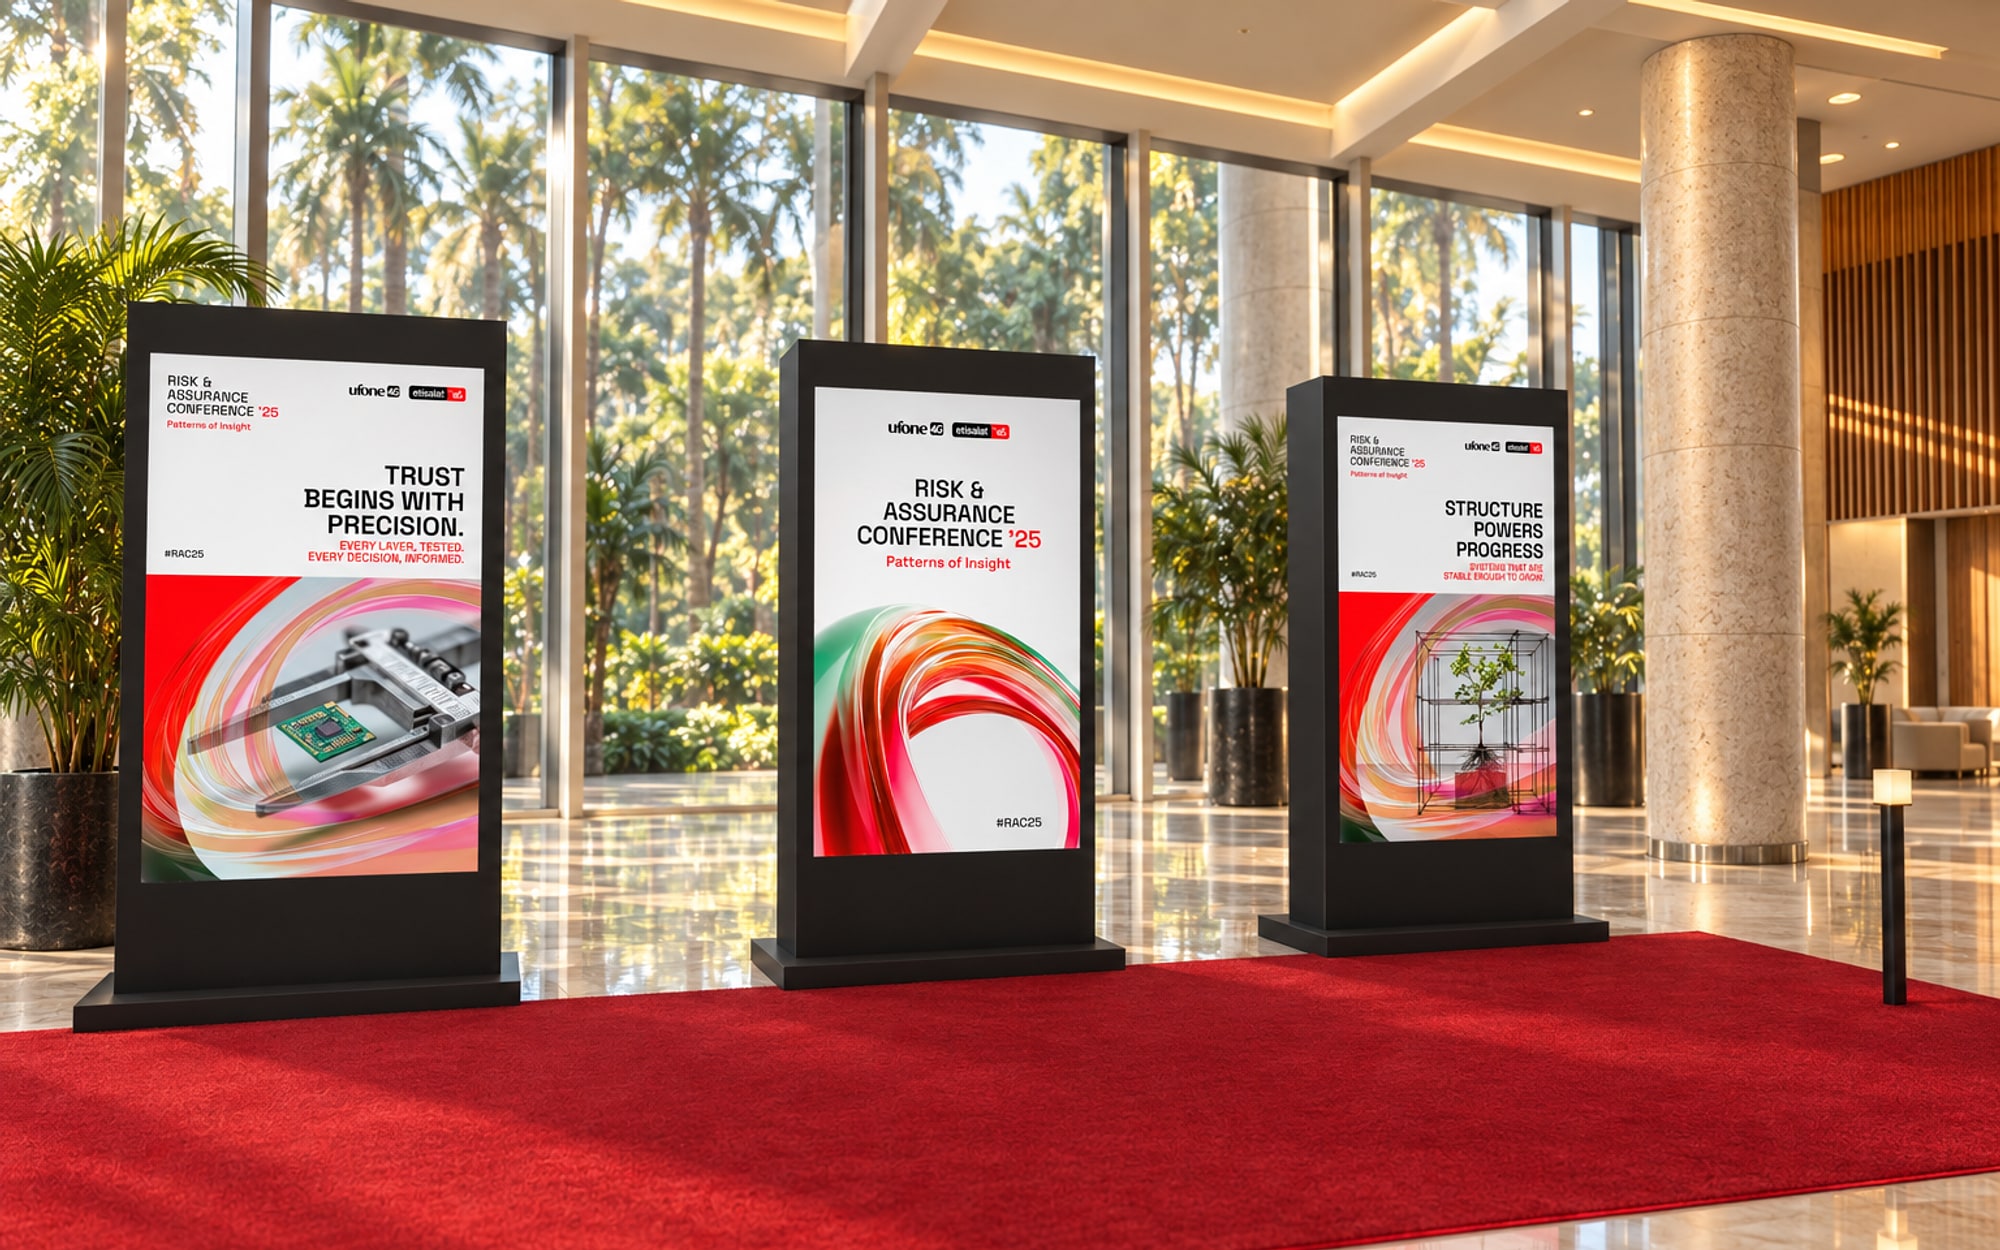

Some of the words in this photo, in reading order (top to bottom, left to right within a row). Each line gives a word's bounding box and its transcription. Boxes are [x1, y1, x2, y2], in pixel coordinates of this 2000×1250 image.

[168, 375, 198, 387] RISK
[203, 376, 212, 388] &
[168, 390, 248, 403] ASSURANCE
[349, 384, 384, 396] ufone
[167, 403, 254, 416] CONFERENCE
[258, 406, 278, 417] '25
[167, 421, 206, 429] Patterns
[208, 421, 218, 430] of
[220, 422, 251, 432] Insight
[889, 421, 928, 434] ufone
[931, 423, 943, 435] 4G
[956, 426, 988, 435] etisalat
[1351, 435, 1370, 443] RISK
[1351, 446, 1405, 456] ASSURANCE
[1465, 441, 1490, 451] ufone
[385, 466, 464, 486] TRUST
[915, 479, 963, 498] RISK
[971, 481, 984, 498] &
[305, 489, 393, 510] BEGINS
[402, 492, 463, 511] WITH
[884, 502, 1015, 524] ASSURANCE
[1445, 500, 1543, 518] STRUCTURE
[328, 515, 463, 536] PRECISION.
[1474, 522, 1543, 538] POWERS
[858, 526, 1003, 547] CONFERENCE
[1009, 530, 1041, 548] '25
[340, 541, 376, 551] EVERY
[420, 542, 464, 552] TESTED.
[1457, 542, 1543, 558] PROGRESS
[165, 550, 204, 558] #RAC25
[308, 552, 344, 562] EVERY
[405, 554, 464, 564] INFORMED.
[887, 556, 944, 568] Patterns
[948, 557, 961, 568] of
[965, 557, 1011, 571] Insight
[996, 817, 1042, 828] #RAC25
